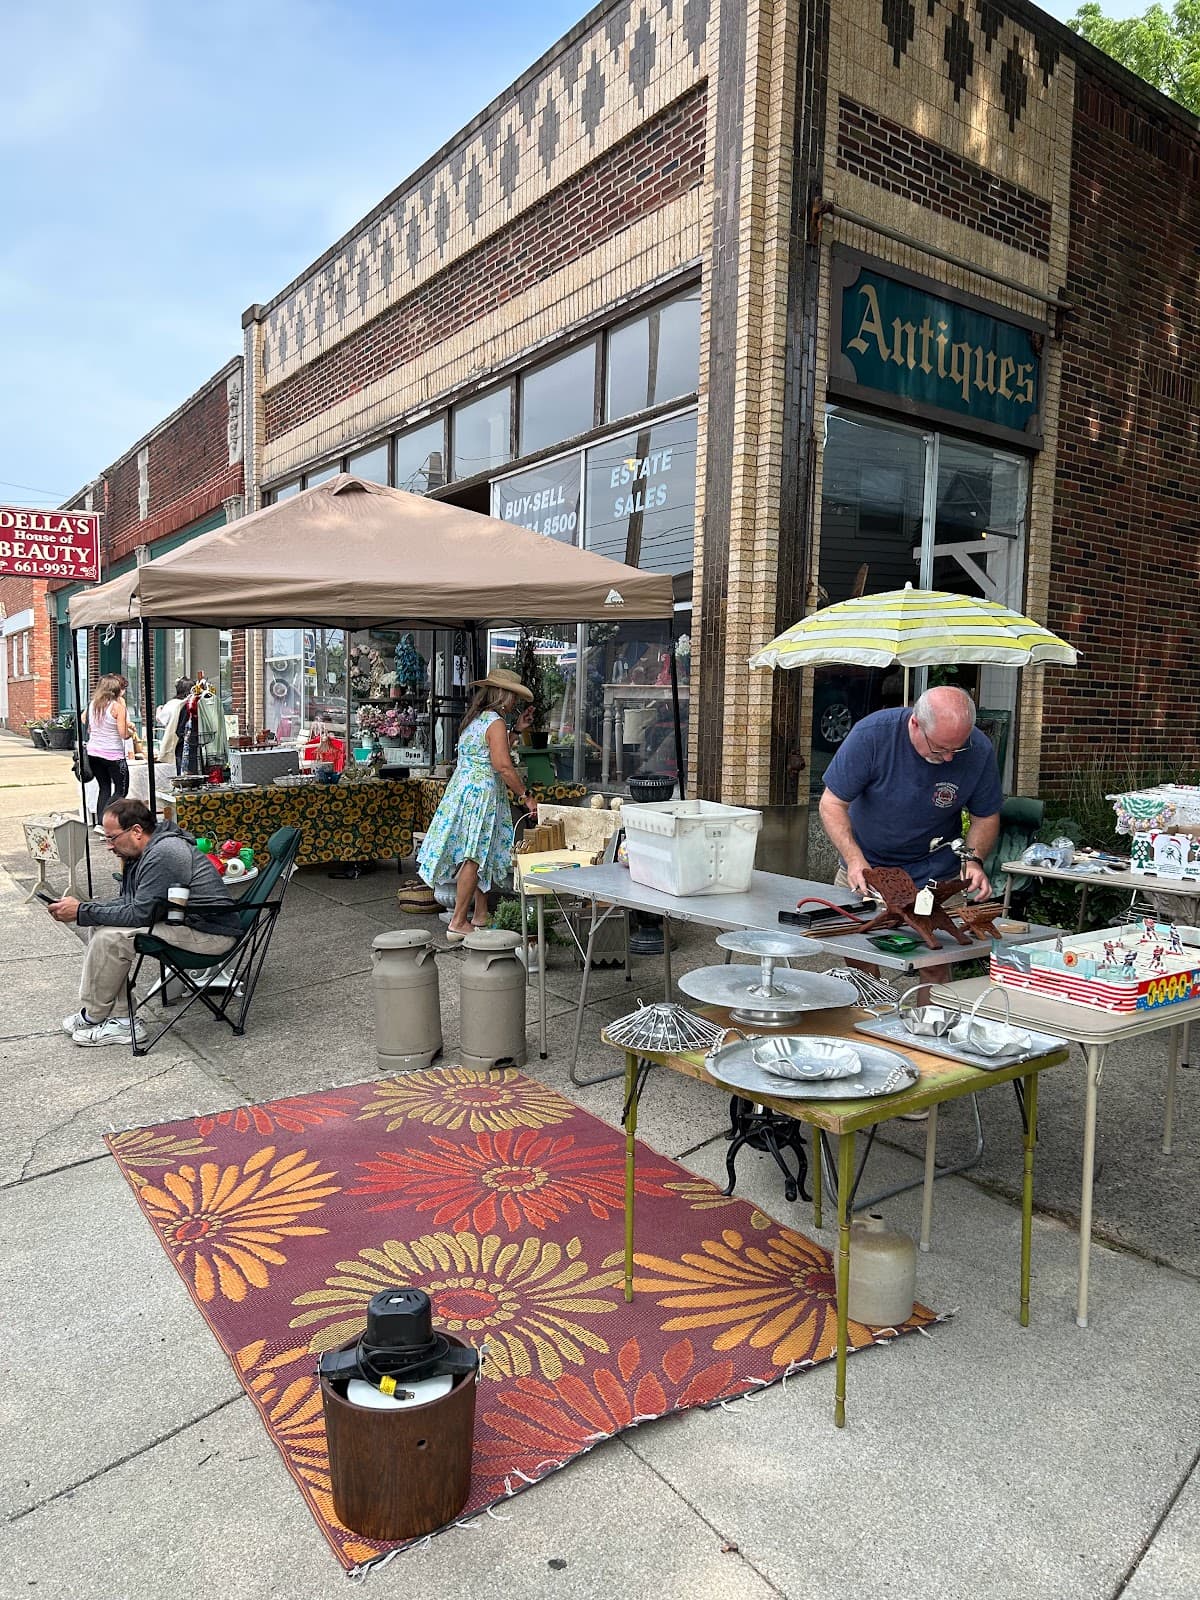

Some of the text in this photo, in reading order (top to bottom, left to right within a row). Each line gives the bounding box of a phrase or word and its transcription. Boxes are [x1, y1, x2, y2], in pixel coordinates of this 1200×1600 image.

[847, 284, 1034, 403] Antiques
[610, 449, 673, 488] ESTATE
[505, 486, 565, 520] BUY-SELL
[613, 483, 668, 518] SALES
[0, 512, 90, 535] DELLA'S
[14, 529, 74, 544] House of
[0, 541, 91, 563] BEAUTY
[14, 561, 76, 576] 661-9937
